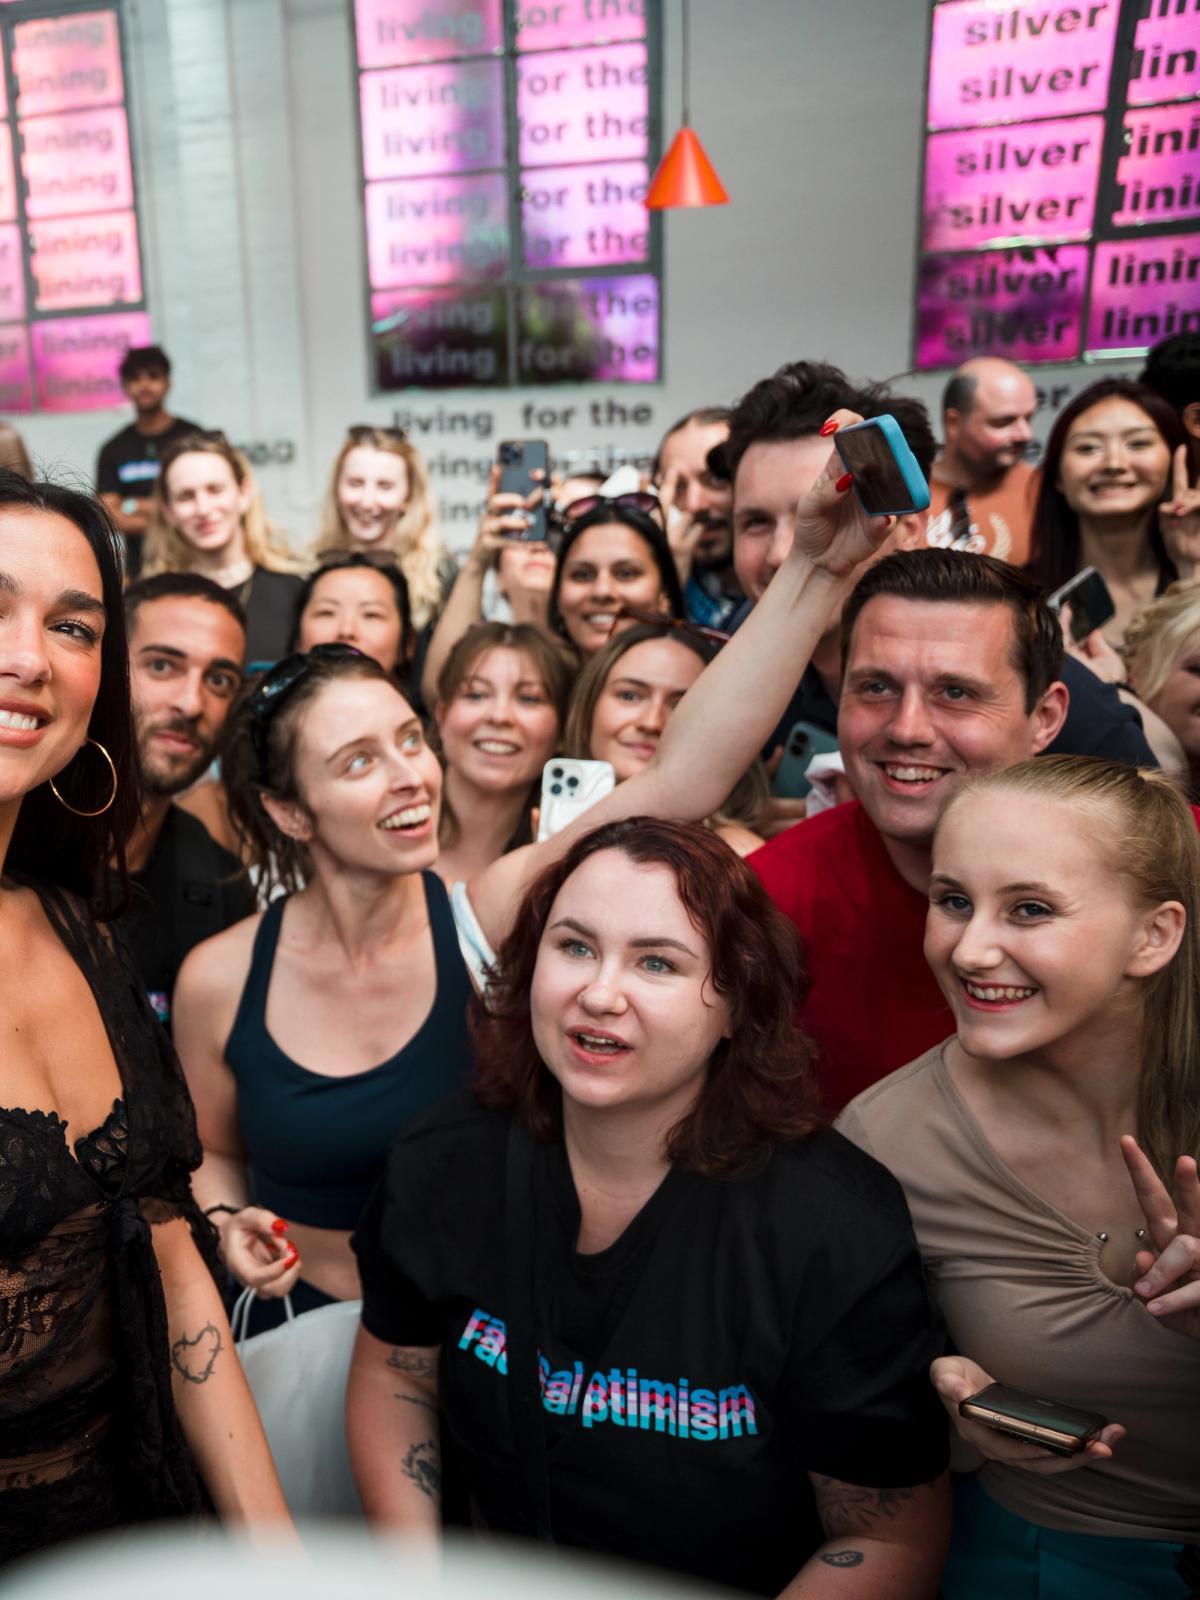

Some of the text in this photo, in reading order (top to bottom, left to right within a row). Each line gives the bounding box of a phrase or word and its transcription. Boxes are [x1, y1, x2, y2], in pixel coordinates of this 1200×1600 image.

[376, 11, 482, 45] living
[522, 4, 567, 28] or
[965, 4, 1108, 45] silver
[381, 77, 486, 111] living
[521, 61, 647, 96] or the
[959, 62, 1100, 104] silver
[384, 127, 488, 158] living
[522, 112, 648, 145] or the
[955, 140, 1091, 176] silver
[386, 194, 489, 222] living
[527, 177, 648, 210] or the
[950, 194, 1085, 230] silver
[389, 241, 491, 269] living
[529, 225, 648, 258] or the
[947, 264, 1079, 300] silver
[945, 313, 1073, 350] silver
[391, 343, 494, 379] living
[394, 399, 652, 440] living for the
[582, 1367, 758, 1441] ptimism
